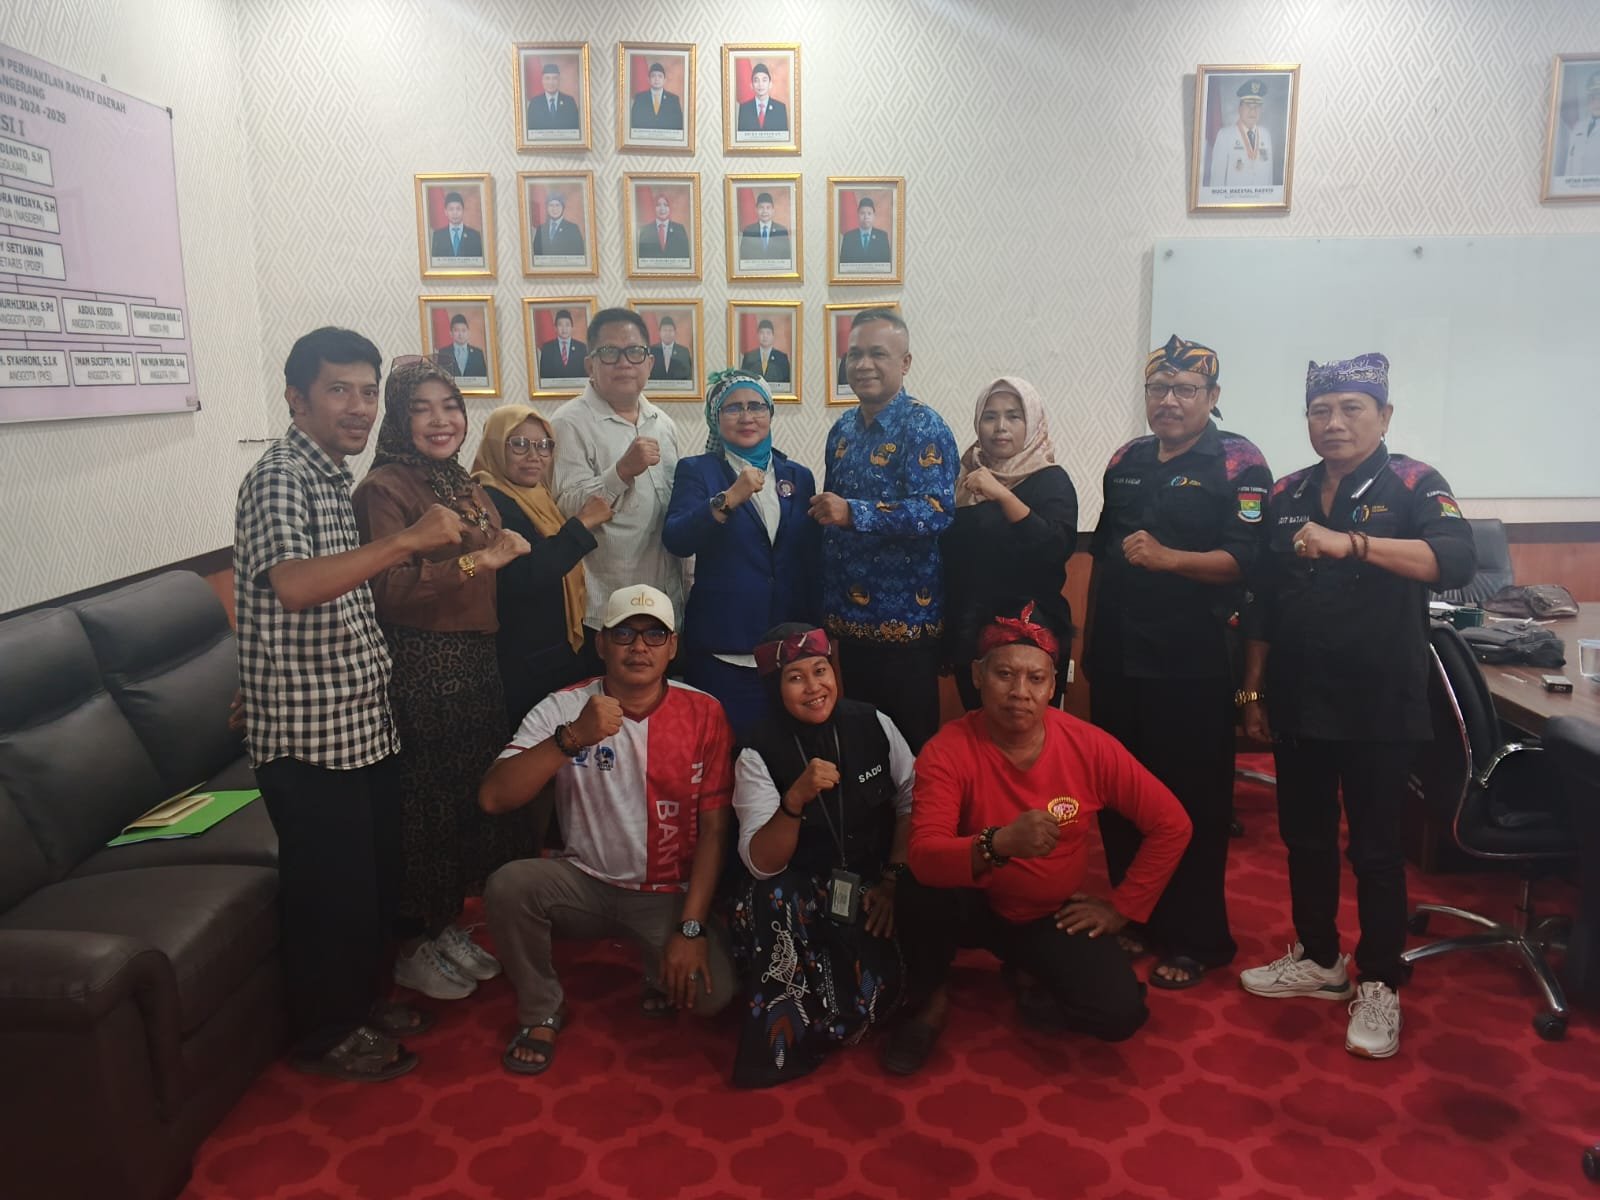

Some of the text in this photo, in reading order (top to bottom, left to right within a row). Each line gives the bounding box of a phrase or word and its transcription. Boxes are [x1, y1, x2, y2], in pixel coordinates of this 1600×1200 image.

[8, 58, 63, 90] PERWAKILAN
[65, 81, 95, 102] RAKYAT
[19, 97, 40, 115] 2024
[6, 242, 43, 257] SETIAWAN
[858, 764, 882, 783] SADO
